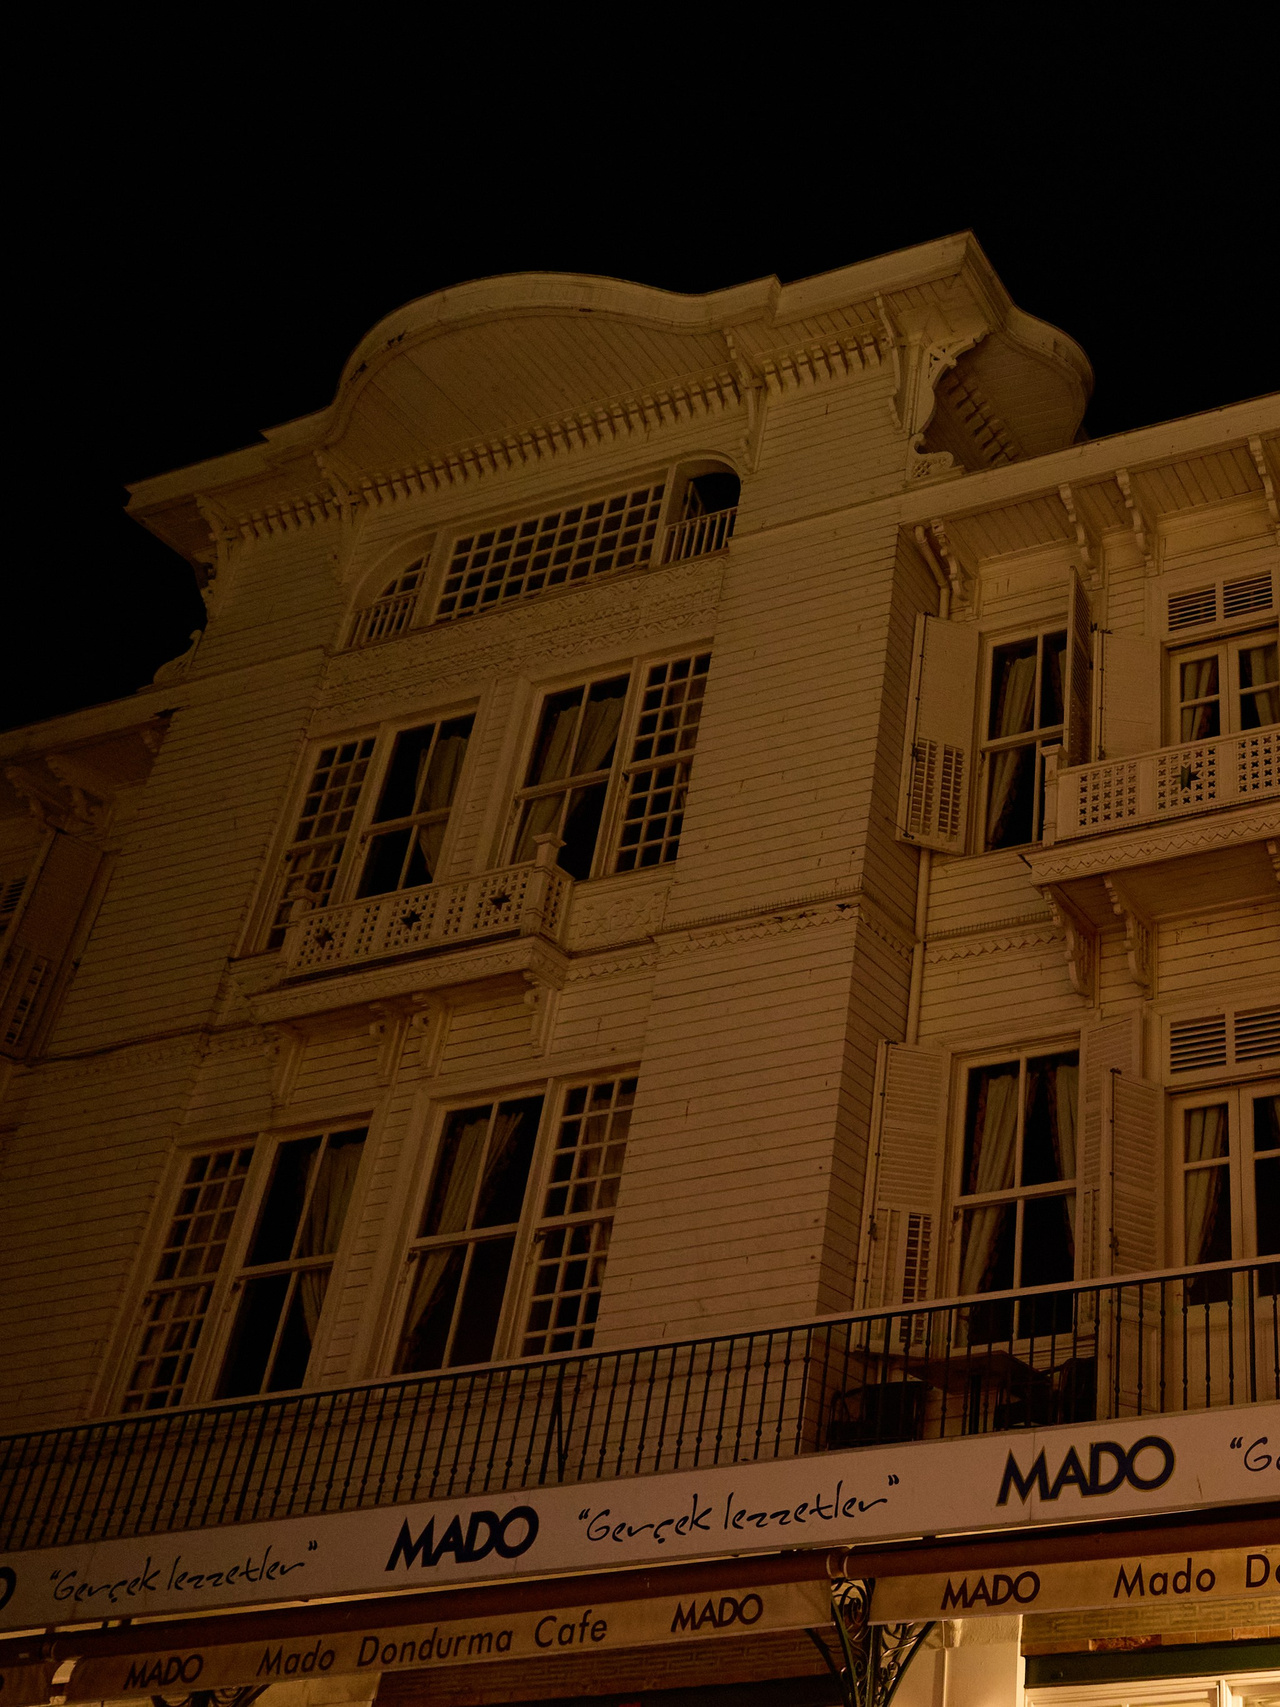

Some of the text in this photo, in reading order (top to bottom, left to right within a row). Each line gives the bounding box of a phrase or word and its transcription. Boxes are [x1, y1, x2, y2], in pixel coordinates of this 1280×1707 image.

[996, 1435, 1176, 1507] MADO
[384, 1505, 541, 1573] MADO
[940, 1571, 1041, 1610] MADO
[1112, 1557, 1217, 1599] Mado
[670, 1593, 764, 1633] MADO
[256, 1610, 609, 1677] Mado Dondurma Cafe
[123, 1654, 204, 1690] MADO
